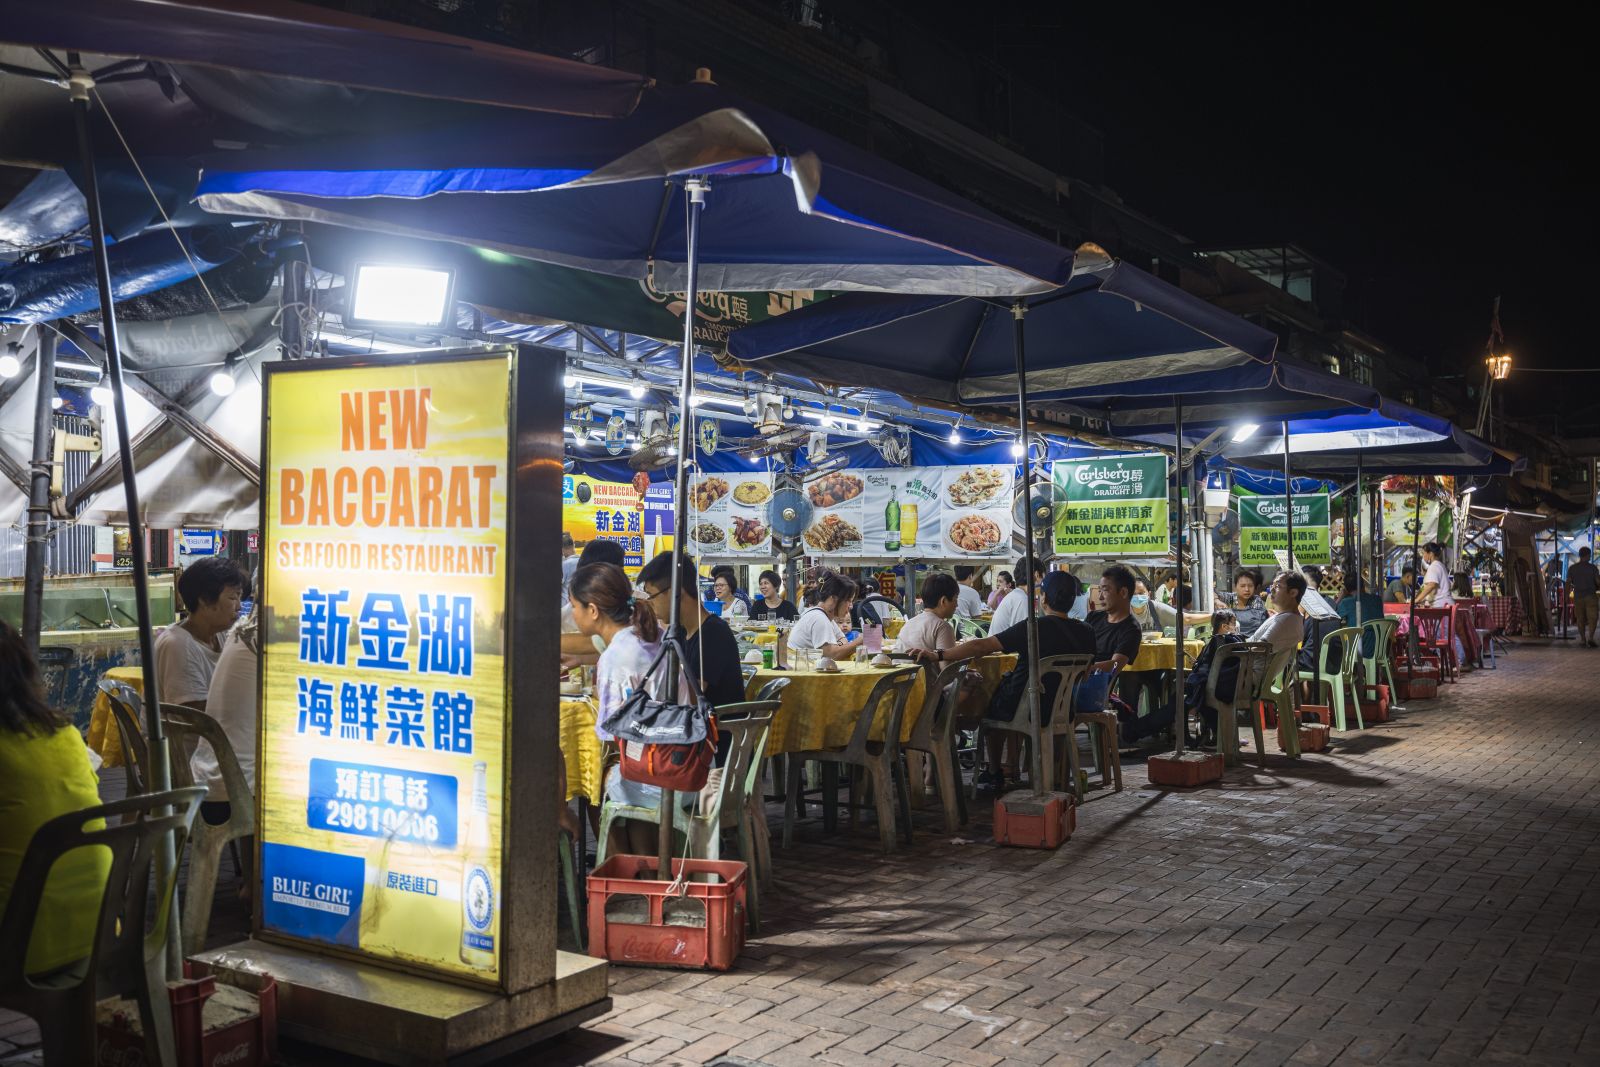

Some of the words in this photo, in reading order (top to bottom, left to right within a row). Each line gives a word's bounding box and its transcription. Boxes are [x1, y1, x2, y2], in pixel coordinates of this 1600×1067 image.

[341, 388, 431, 451] NEW
[1075, 464, 1131, 484] Carlsberg
[280, 465, 497, 528] BACCARAT
[593, 485, 608, 495] NEW
[609, 486, 640, 497] BACCARA
[595, 510, 640, 532] 新金湖
[1066, 506, 1152, 520] 新金湖海鮮酒家
[1057, 537, 1099, 546] SEAFOOD
[1102, 536, 1165, 545] RESTAURANT
[1065, 525, 1092, 534] NEW
[1094, 523, 1154, 534] BACCARAT
[279, 541, 361, 569] SEAFOOD
[367, 543, 496, 575] RESTAURANT
[299, 588, 473, 676] 新金湖
[297, 677, 474, 755] 海鮮菜館
[335, 767, 429, 811] 預訂電話
[273, 876, 312, 897] BLUE
[314, 883, 351, 905] GIRL
[387, 871, 438, 896] 原裝進口
